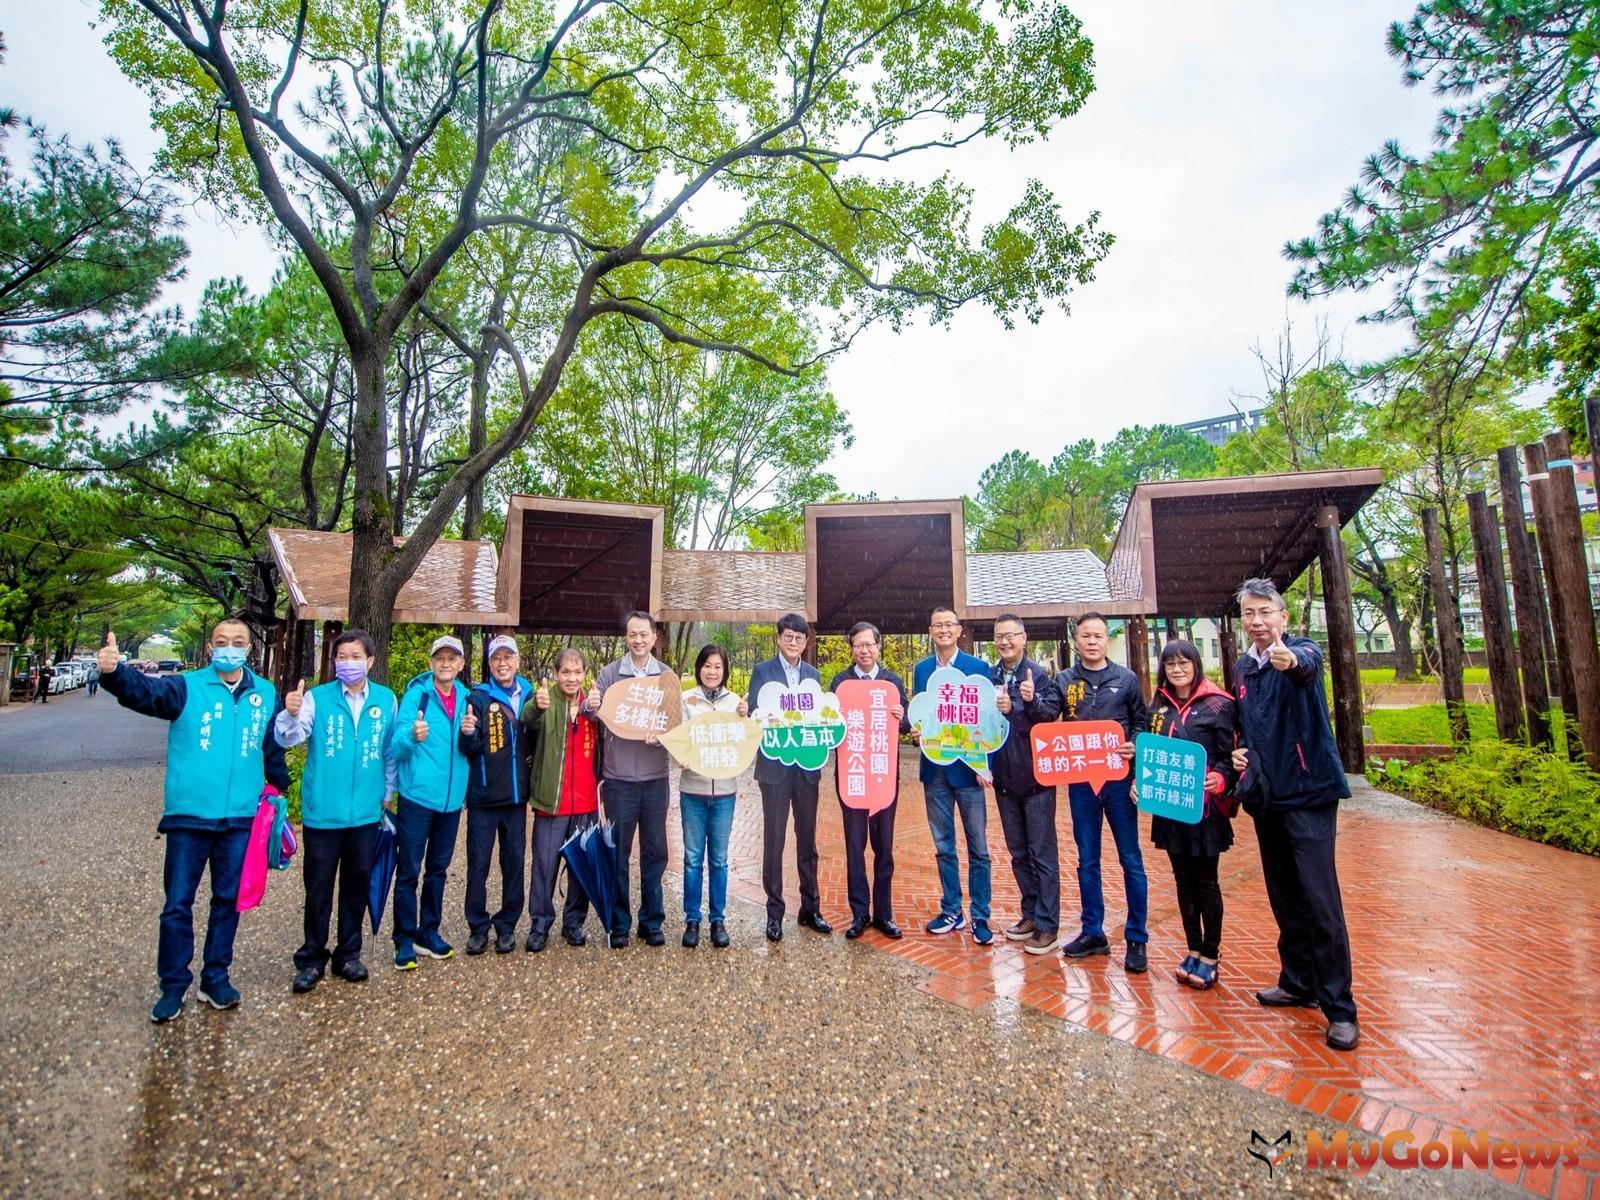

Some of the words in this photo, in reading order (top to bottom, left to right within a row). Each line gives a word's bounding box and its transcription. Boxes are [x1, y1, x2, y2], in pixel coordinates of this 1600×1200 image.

[626, 684, 664, 707] 生物
[779, 692, 814, 711] 桃園
[937, 683, 981, 704] 幸福
[613, 702, 669, 733] 多樣性
[937, 703, 980, 725] 桃園
[688, 723, 748, 745] 低衝擊
[763, 727, 836, 749] 以人為本
[1051, 732, 1120, 753] 公園跟你
[700, 746, 740, 770] 開發
[847, 709, 867, 797] 樂遊公園
[1037, 752, 1125, 775] 想的不一樣
[1142, 747, 1196, 770] 打造友善
[1155, 767, 1196, 790] 宜居的
[1141, 784, 1195, 810] 都市綠洲
